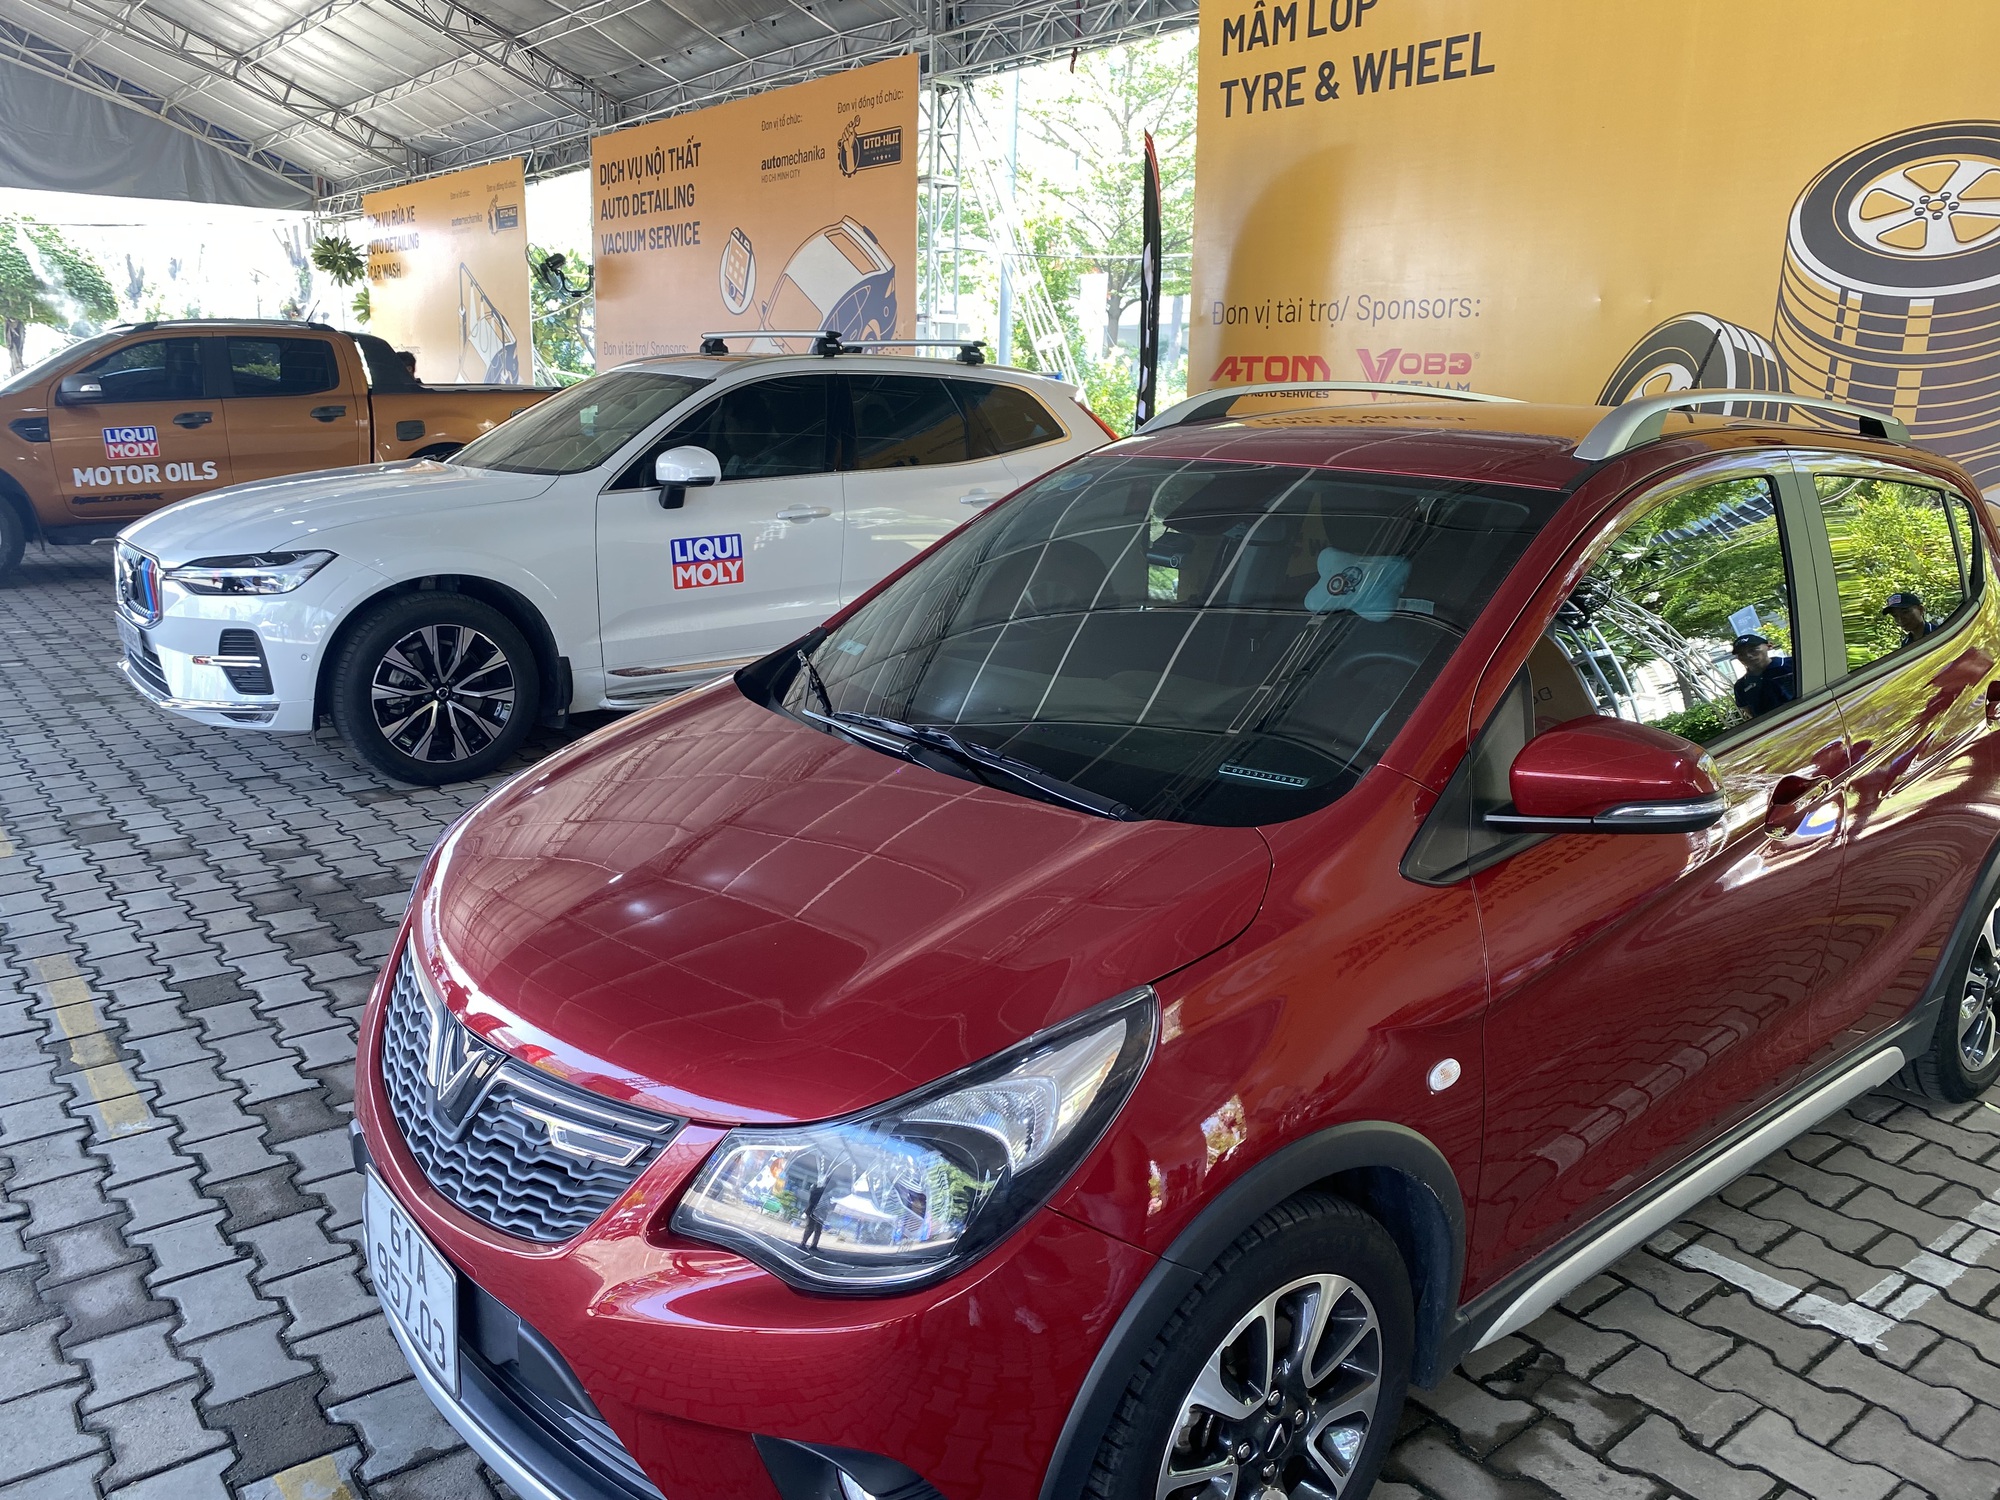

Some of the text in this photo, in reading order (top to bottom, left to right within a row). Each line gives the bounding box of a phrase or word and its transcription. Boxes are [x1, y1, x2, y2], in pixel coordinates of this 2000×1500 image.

[1221, 0, 1298, 57] MÂM
[1220, 31, 1495, 118] TYRE & WHEEL
[863, 132, 900, 150] OTO-HUI
[600, 135, 701, 190] DỊCH VỤ NỘI THẤT
[761, 145, 826, 171] automechanika
[406, 205, 415, 223] XE
[601, 183, 695, 221] AUTO DETAILING
[385, 232, 419, 254] DETAILING
[601, 221, 701, 255] VACUUM SERVICE
[370, 261, 401, 280] CAR WASH
[1212, 301, 1249, 325] Đơn
[1254, 299, 1271, 330] vị
[1277, 297, 1302, 324] tài
[1356, 294, 1481, 327] Sponsors:
[1209, 355, 1332, 382] ATOM
[1279, 390, 1329, 399] SERVICES
[105, 428, 155, 443] LIQUI
[108, 443, 157, 458] MOLY
[72, 461, 218, 488] MOTOR OILS
[673, 535, 740, 563] LIQUI
[676, 560, 742, 588] MOLY
[389, 1207, 428, 1296] 61A
[377, 1242, 446, 1371] 957.03
